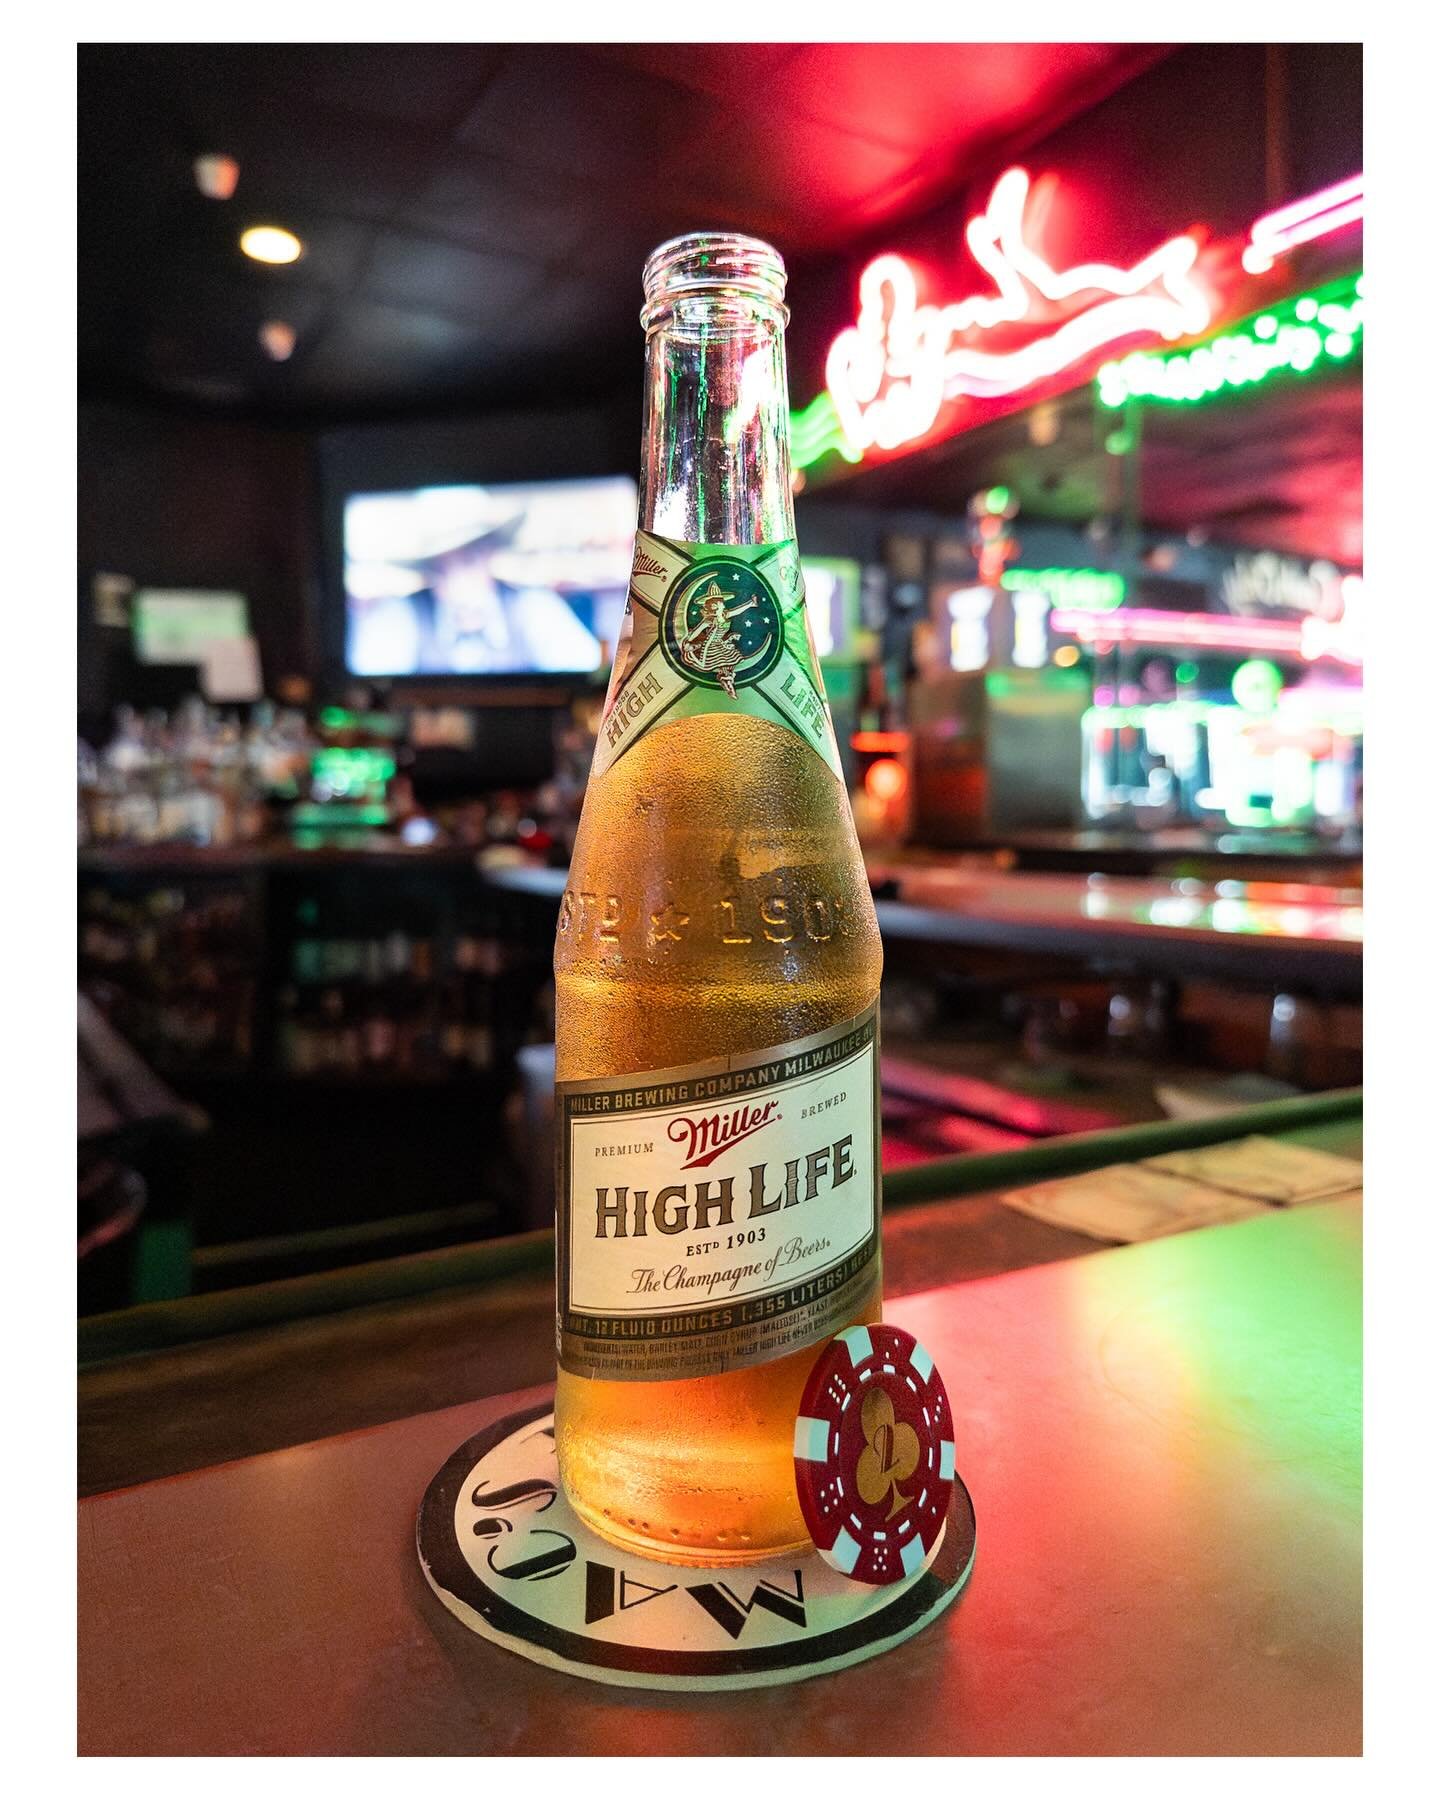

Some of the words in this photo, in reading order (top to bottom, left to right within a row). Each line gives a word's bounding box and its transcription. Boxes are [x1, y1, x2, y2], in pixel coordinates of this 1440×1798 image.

[632, 546, 668, 577] Miller
[606, 672, 663, 748] HIGH
[780, 673, 825, 738] LIFE
[570, 1095, 609, 1112] MILLER
[615, 1085, 688, 1109] BREWING
[695, 1065, 780, 1097] COMPANY
[785, 1032, 861, 1077] MILWAUKEE
[594, 1142, 654, 1157] PREMIUM
[667, 1100, 779, 1166] Miller
[801, 1091, 847, 1119] BREWED
[595, 1177, 735, 1238] HIGH
[747, 1134, 854, 1219] LIFE
[626, 1268, 661, 1294] The
[663, 1261, 762, 1295] Champagne
[764, 1246, 783, 1281] of
[686, 1241, 720, 1257] ESTD
[726, 1228, 767, 1250] 1903
[595, 1320, 609, 1335] 12
[612, 1320, 655, 1336] FLUID
[661, 1309, 732, 1334] OUNCES
